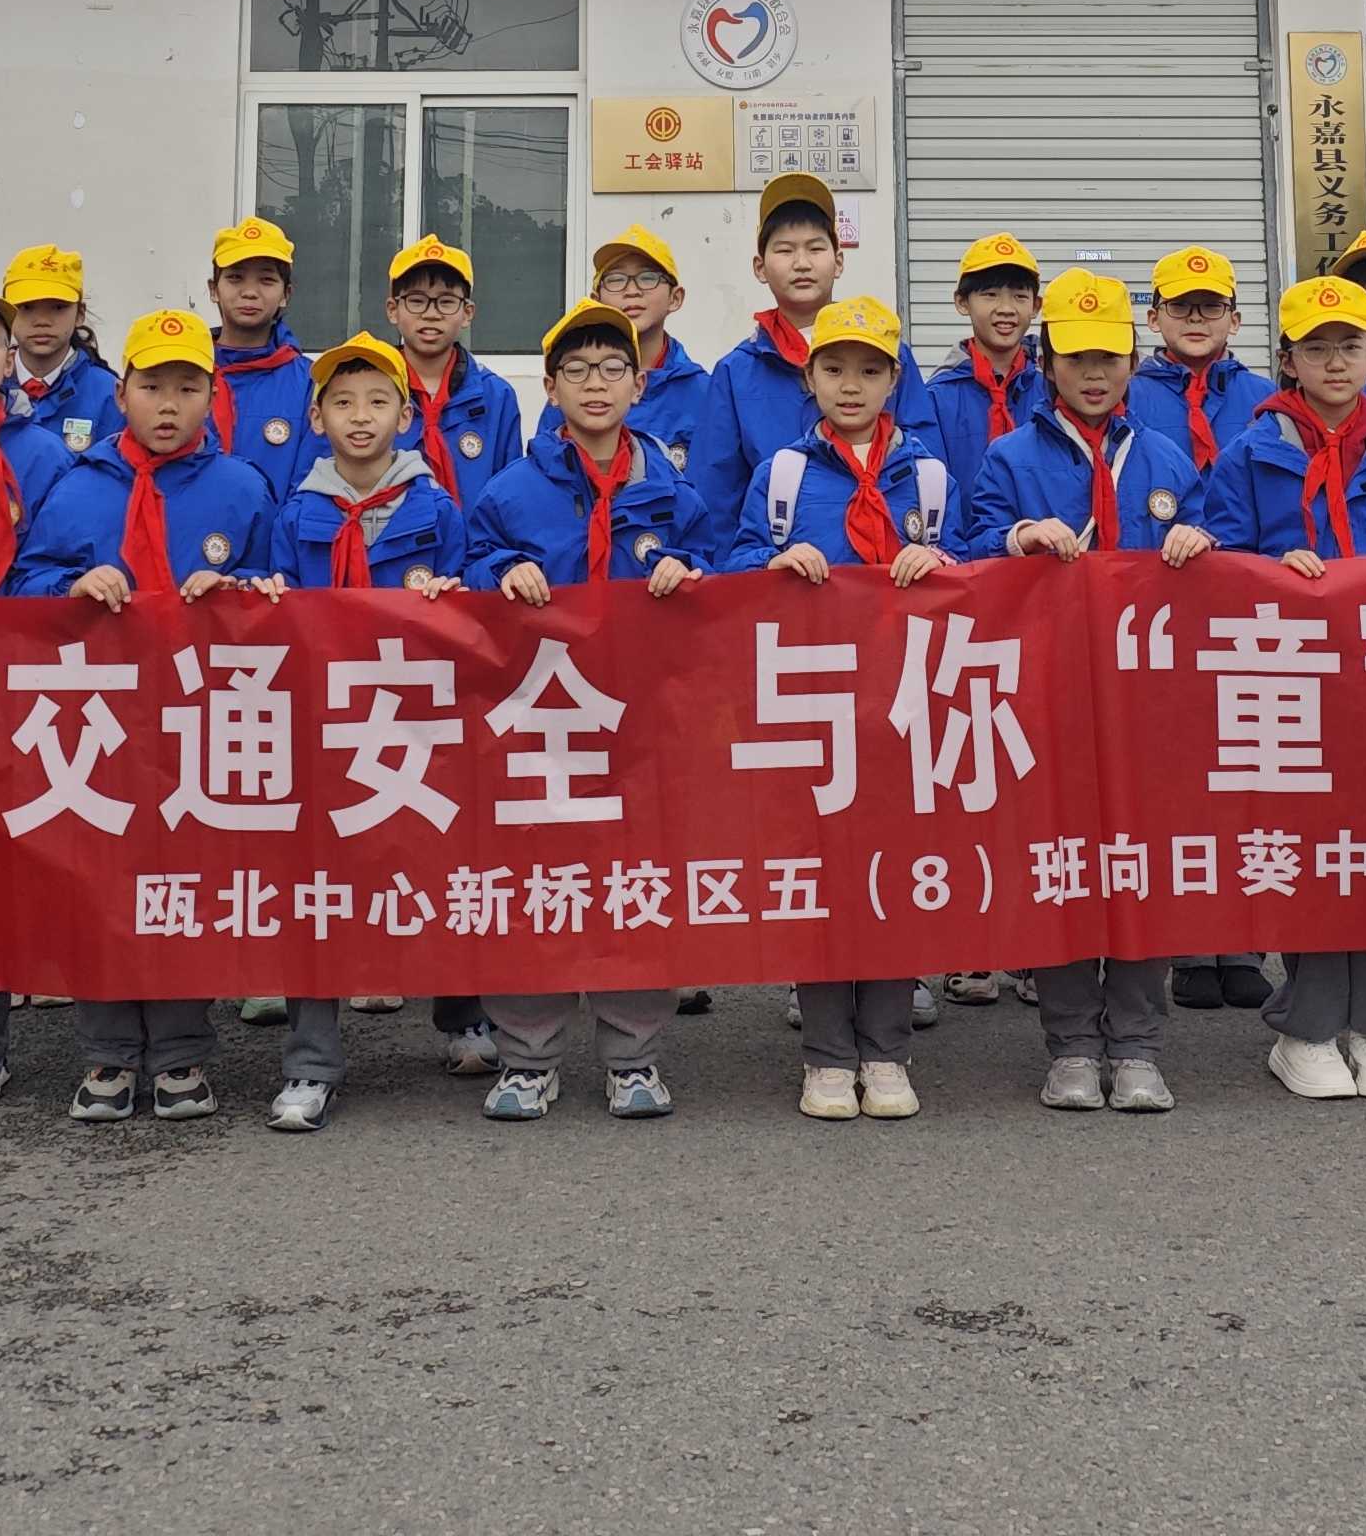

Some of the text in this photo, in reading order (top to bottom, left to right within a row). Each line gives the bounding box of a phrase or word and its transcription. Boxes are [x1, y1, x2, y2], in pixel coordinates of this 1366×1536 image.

[624, 152, 704, 171] 工会驿站
[2, 637, 627, 838] 交通安全
[731, 613, 1036, 816] 与你
